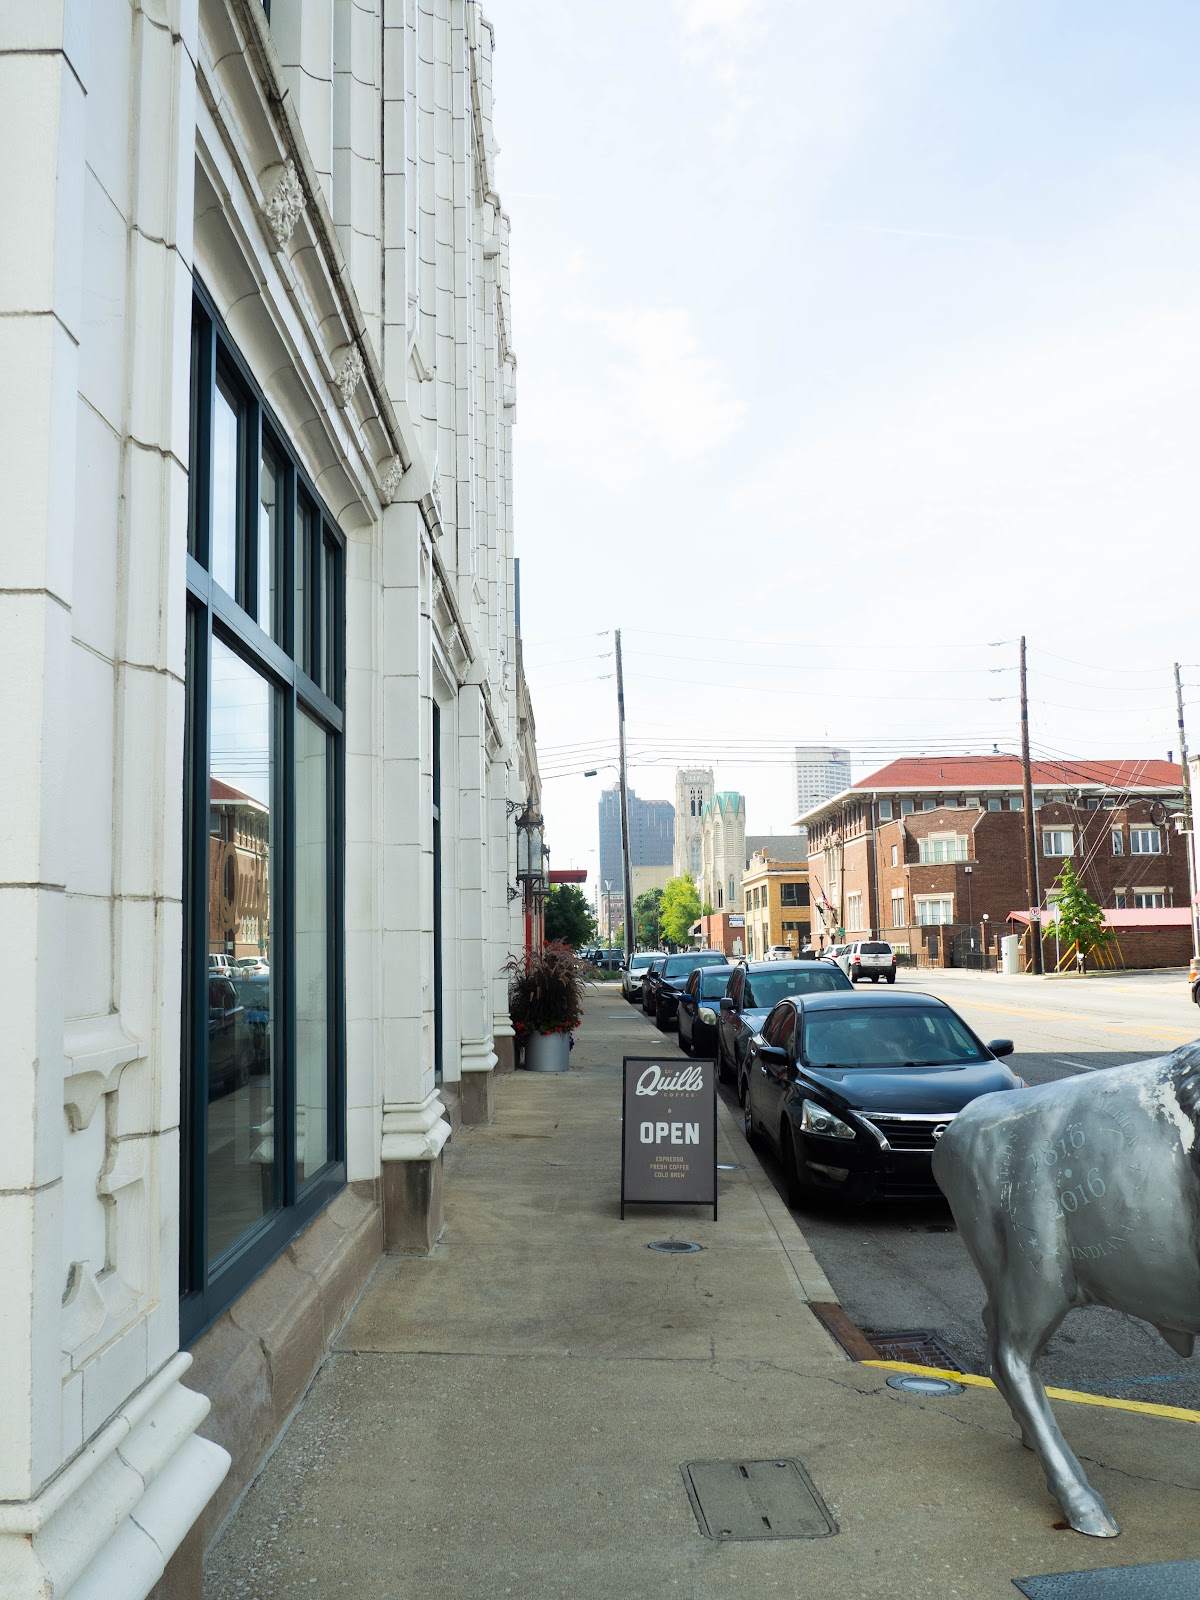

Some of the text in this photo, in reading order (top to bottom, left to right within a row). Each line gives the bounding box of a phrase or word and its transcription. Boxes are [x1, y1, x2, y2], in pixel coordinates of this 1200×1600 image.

[220, 842, 268, 934] Quills
[635, 1065, 704, 1096] Quills
[640, 1121, 700, 1145] OPEN
[1026, 1122, 1086, 1172] 1816
[1045, 1167, 1106, 1222] 2016
